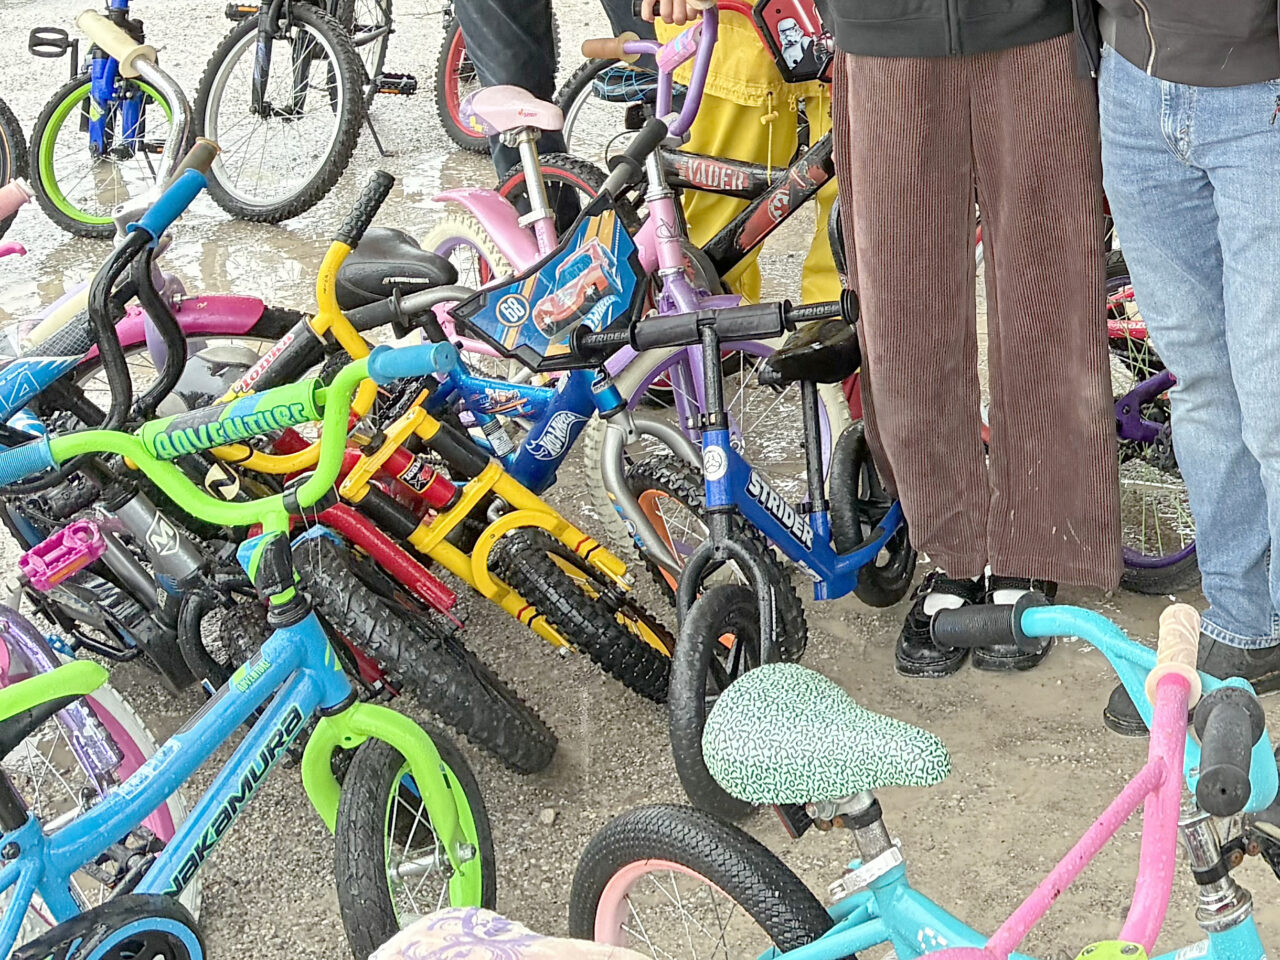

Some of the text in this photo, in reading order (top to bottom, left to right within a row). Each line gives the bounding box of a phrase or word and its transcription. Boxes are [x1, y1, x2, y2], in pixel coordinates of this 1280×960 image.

[688, 158, 744, 190] VADER
[501, 297, 526, 323] 68
[154, 402, 309, 460] ADVENTURE
[745, 470, 814, 552] STRIDER
